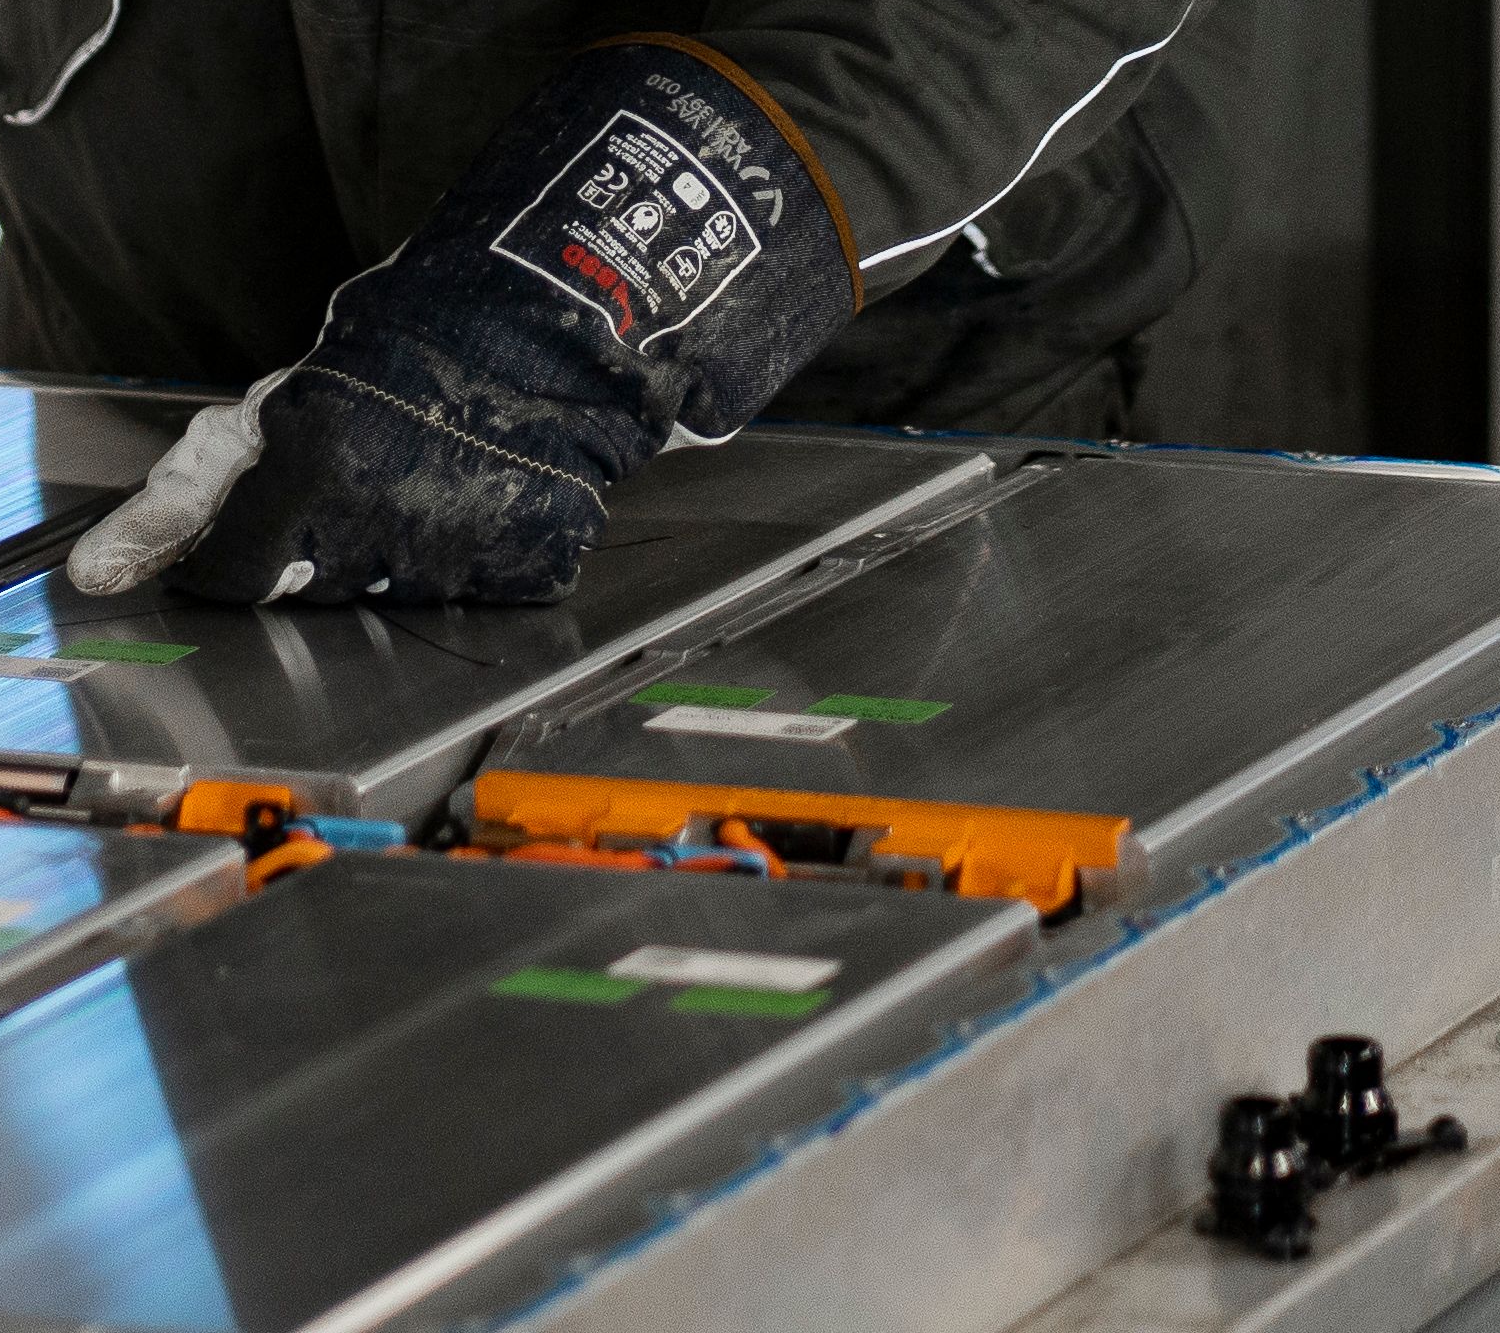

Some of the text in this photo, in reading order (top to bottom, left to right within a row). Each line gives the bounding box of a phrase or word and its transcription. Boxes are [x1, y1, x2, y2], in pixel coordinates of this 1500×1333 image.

[645, 73, 682, 95] 010
[666, 98, 705, 130] VAS
[676, 92, 715, 120] 397
[637, 151, 646, 159] 2
[644, 156, 665, 175] Class
[644, 168, 661, 184] IEC
[682, 181, 692, 190] 4
[568, 228, 587, 243] HRC
[578, 224, 597, 241] HRC
[701, 228, 721, 250] ARC
[611, 255, 650, 289] protective
